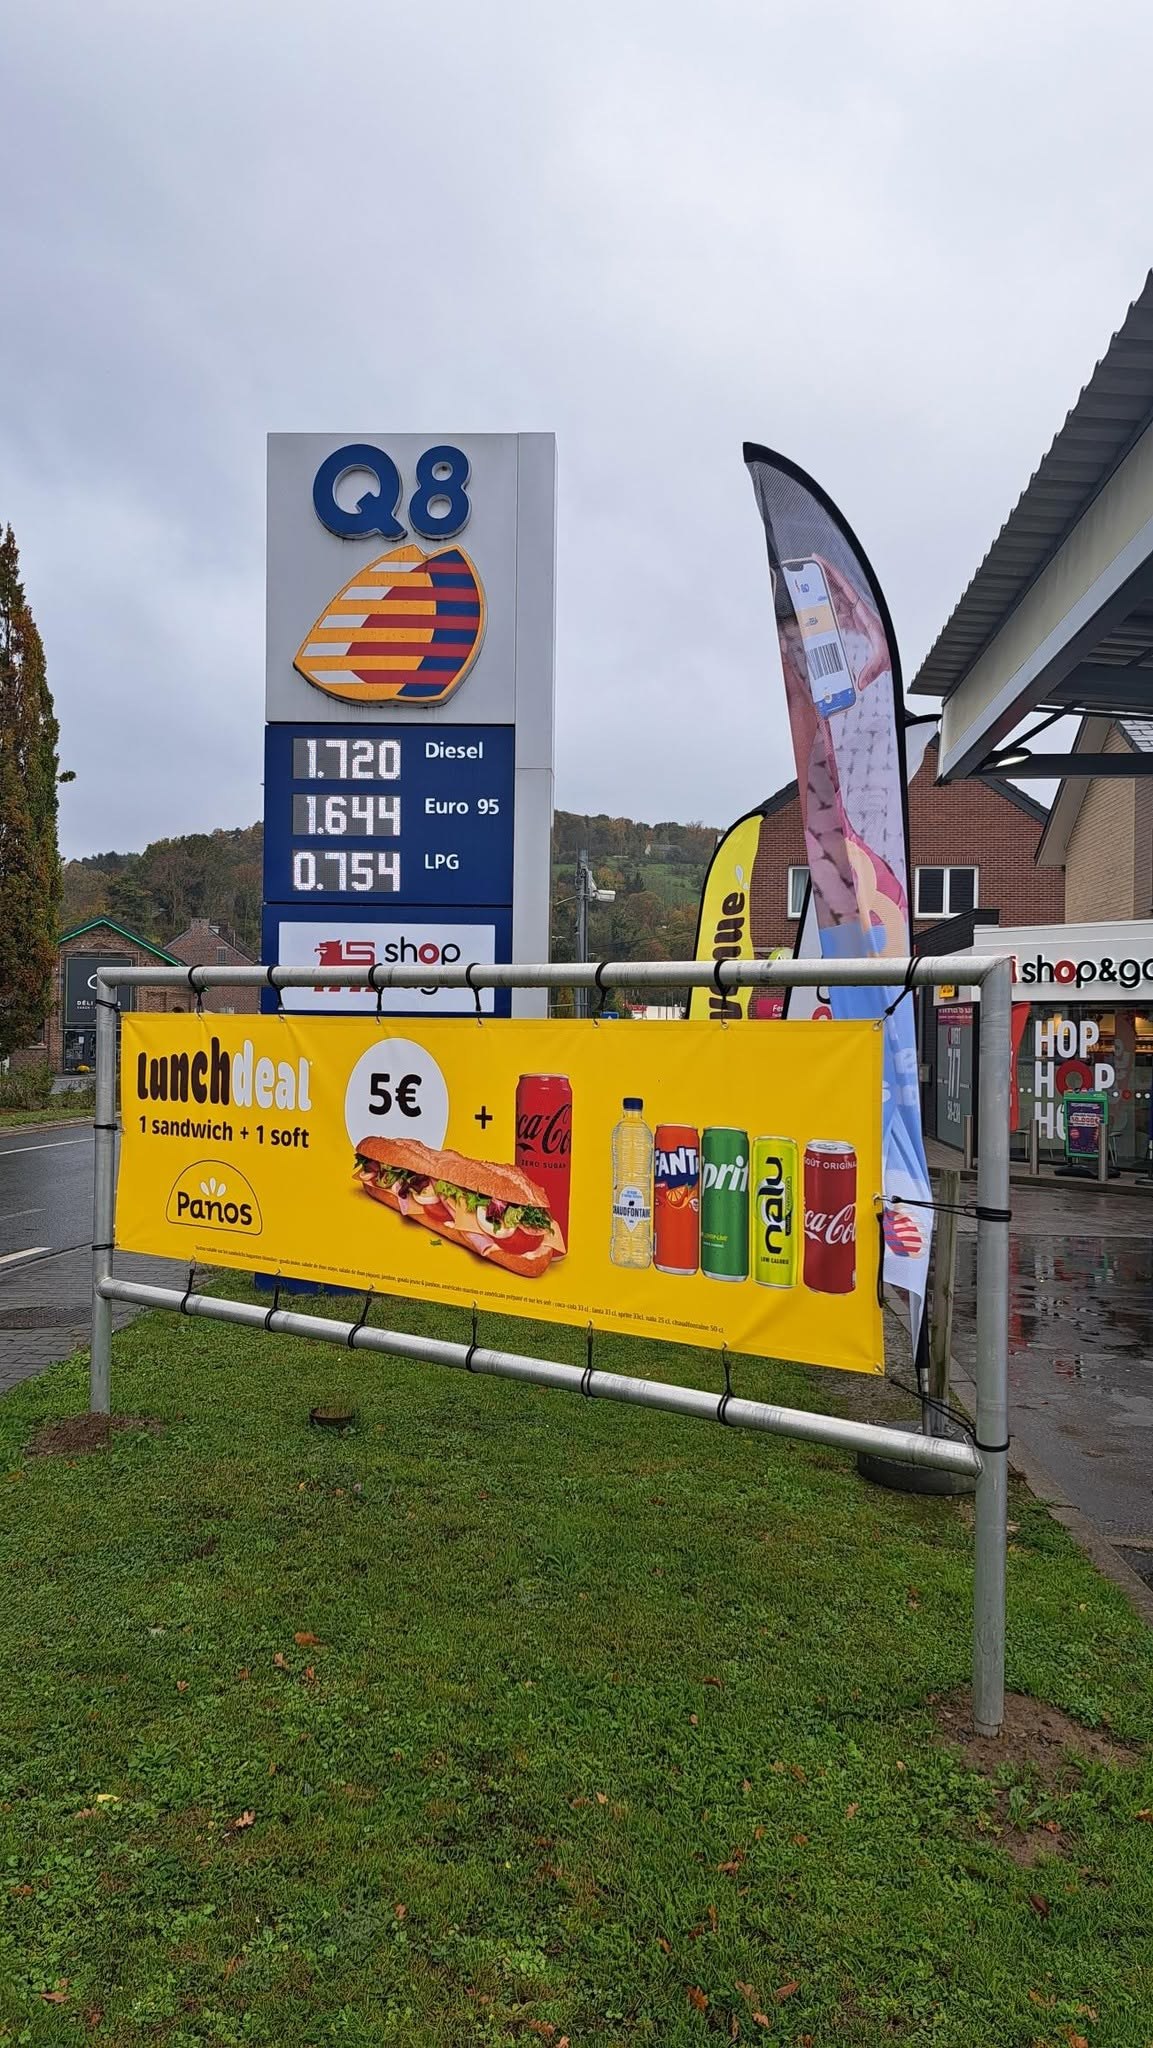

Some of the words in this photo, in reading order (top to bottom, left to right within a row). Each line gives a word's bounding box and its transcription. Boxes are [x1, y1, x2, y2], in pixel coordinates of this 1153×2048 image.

[313, 444, 471, 541] Q8
[306, 740, 400, 779] 1.720
[425, 742, 483, 759] Diesel
[306, 796, 400, 835] 1.644
[425, 798, 469, 815] Euro
[478, 799, 500, 815] 95
[293, 852, 400, 892] 0.754
[425, 854, 460, 870] LPG
[384, 936, 461, 965] shop
[1034, 1020, 1099, 1058] HOP
[368, 1073, 422, 1118] 5€
[139, 1116, 146, 1133] 1
[152, 1118, 232, 1141] sandwich
[240, 1126, 249, 1140] +
[256, 1126, 264, 1144] 1
[270, 1127, 310, 1148] soft
[177, 1192, 252, 1226] Panos
